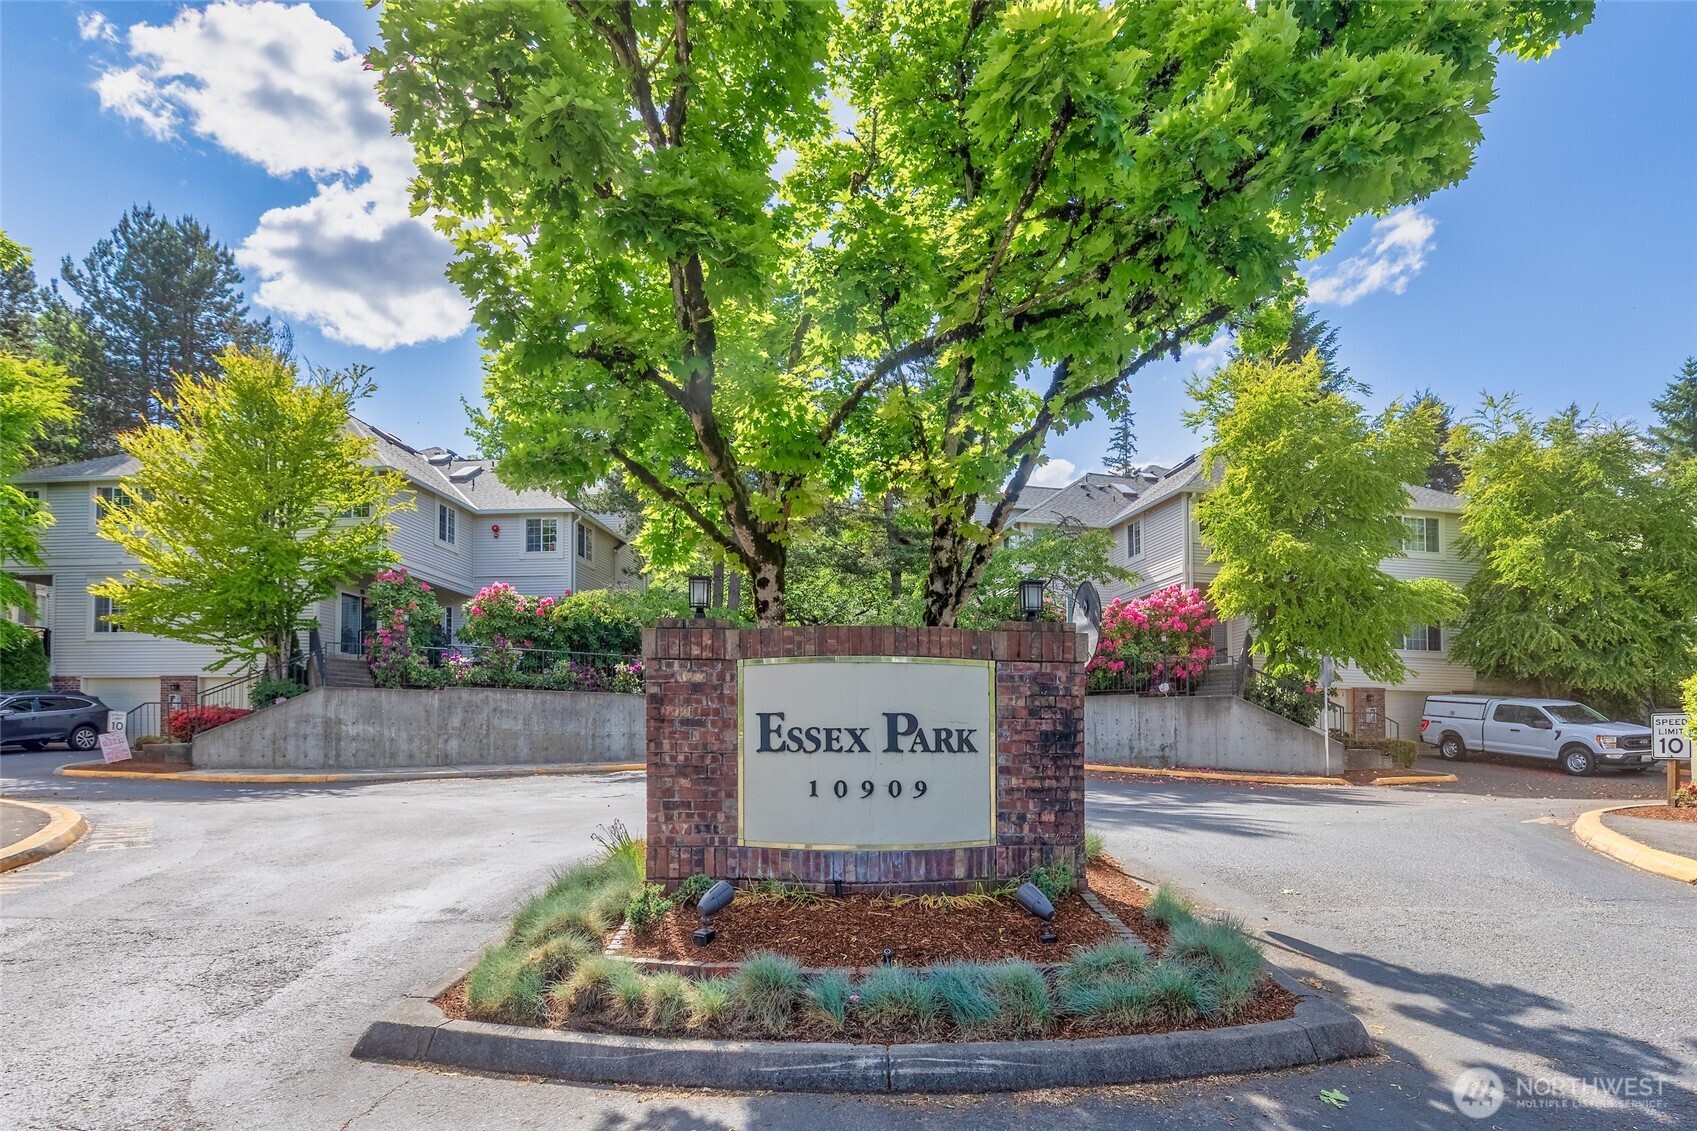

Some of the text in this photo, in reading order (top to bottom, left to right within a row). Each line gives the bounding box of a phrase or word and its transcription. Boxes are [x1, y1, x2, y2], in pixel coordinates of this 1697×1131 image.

[111, 721, 123, 731] 10
[1655, 718, 1688, 726] SPEED
[755, 711, 979, 754] ESSEX PARK
[1659, 737, 1684, 754] 10
[809, 779, 928, 799] 10909
